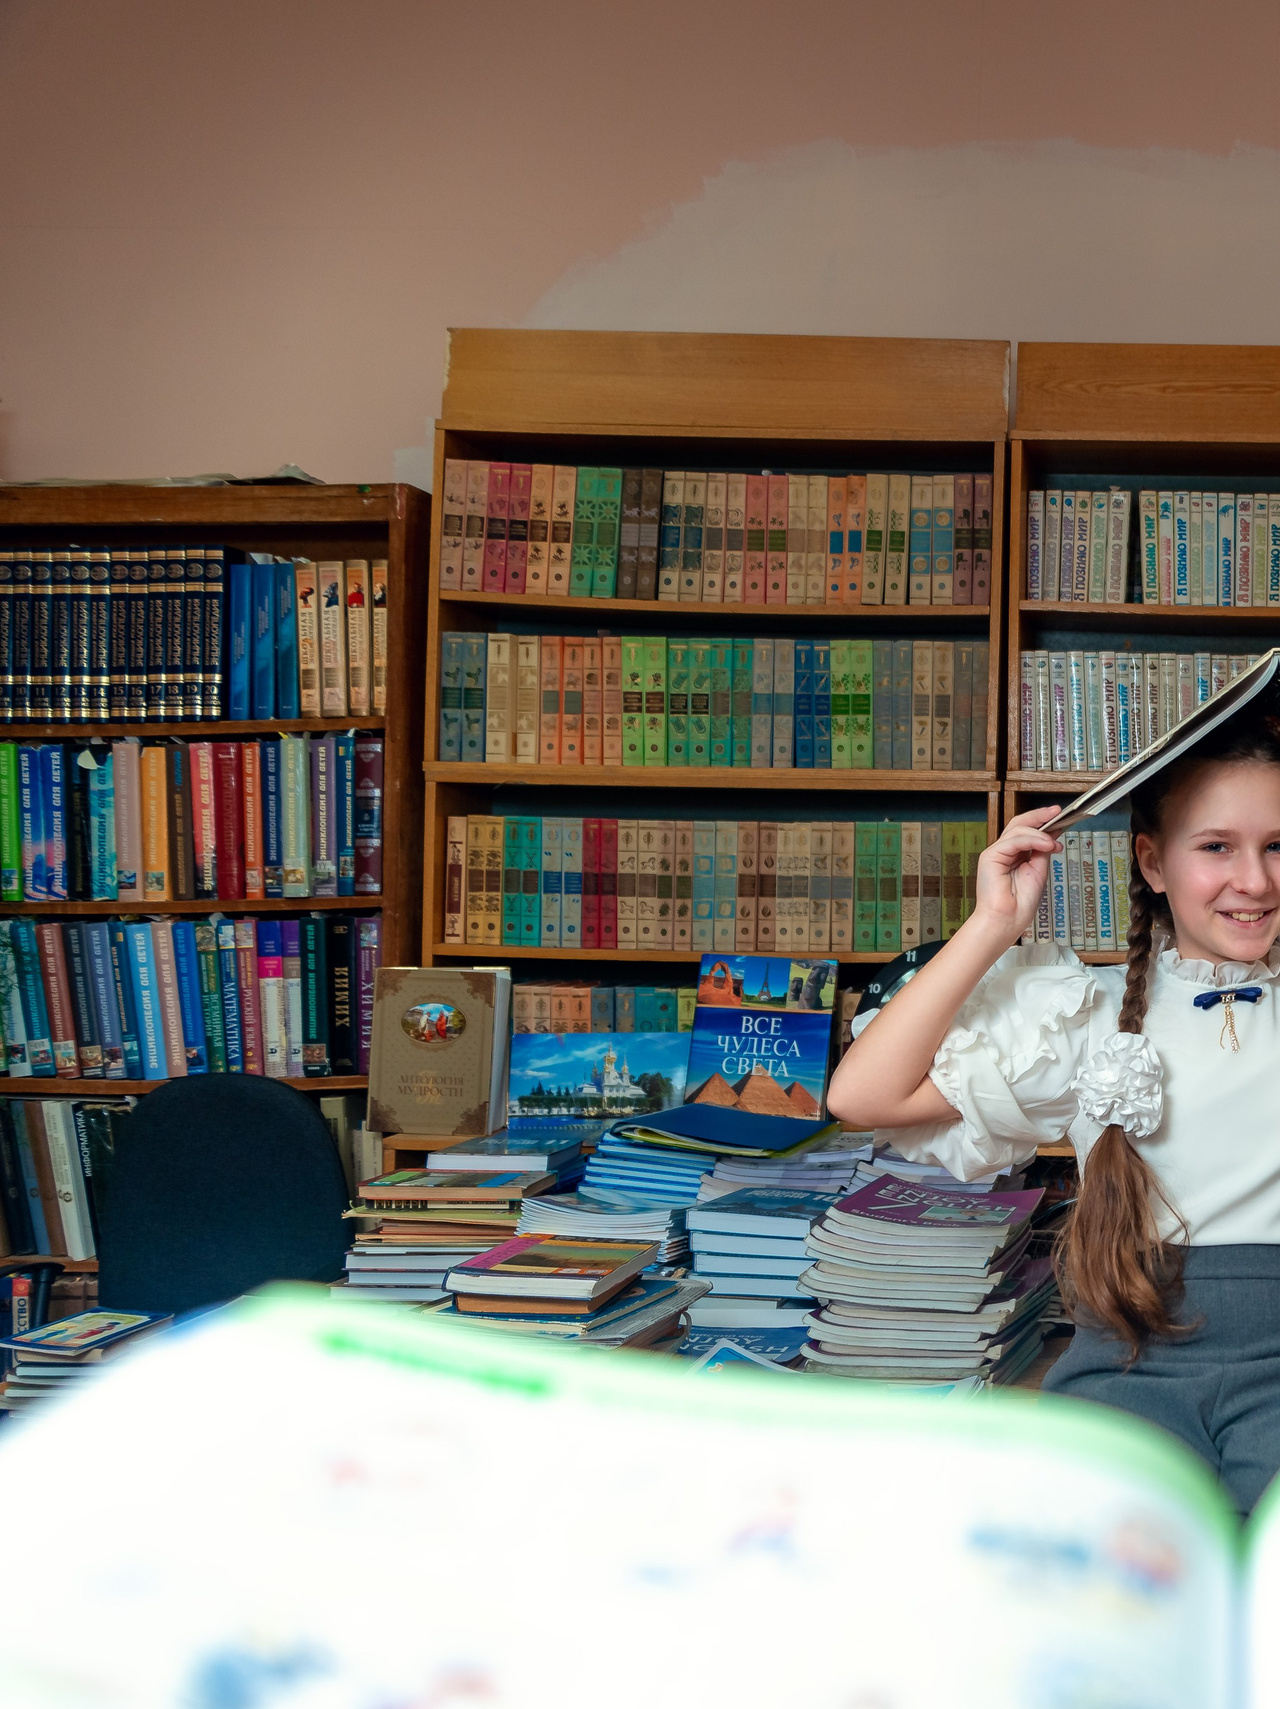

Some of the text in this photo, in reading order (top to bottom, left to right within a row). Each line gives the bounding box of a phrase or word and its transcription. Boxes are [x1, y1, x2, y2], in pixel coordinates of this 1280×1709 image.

[1029, 516, 1040, 541] МИР
[1145, 514, 1155, 540] МИР
[1177, 518, 1188, 596] Я ПОЗНАЮ МИР
[1237, 517, 1250, 604] Я ПОЗНАЮ МИР
[1269, 523, 1280, 602] Я ПОЗНАЮ МИР
[1053, 859, 1066, 939] Я ПОЗНАЮ МИР
[1098, 859, 1112, 939] Я ПОЗНАЮ МИР
[134, 932, 148, 963] ДЕТЕЙ
[906, 950, 917, 962] 11
[138, 967, 150, 987] ДЛЯ
[868, 983, 882, 994] 10
[243, 988, 255, 1025] РУССКИЙ
[334, 966, 350, 1027] ХИМИЯ
[223, 982, 240, 1060] МАТЕМАТИКА
[741, 1016, 782, 1036] ВСЕ
[245, 1026, 255, 1049] ЯЗЫК
[717, 1035, 801, 1058] ЧУДЕСА
[722, 1056, 790, 1078] СВЕТА
[397, 1086, 463, 1097] МУДРОСТИ
[400, 1075, 464, 1086] АНТОЛОГИЯ
[75, 1110, 92, 1177] ИНФОРМАТИКА
[878, 1189, 1017, 1213] ENGLISH
[886, 1183, 984, 1205] ENJOY
[851, 1208, 918, 1225] Student's
[17, 1297, 27, 1334] ССТВО
[686, 1336, 762, 1345] NJOY
